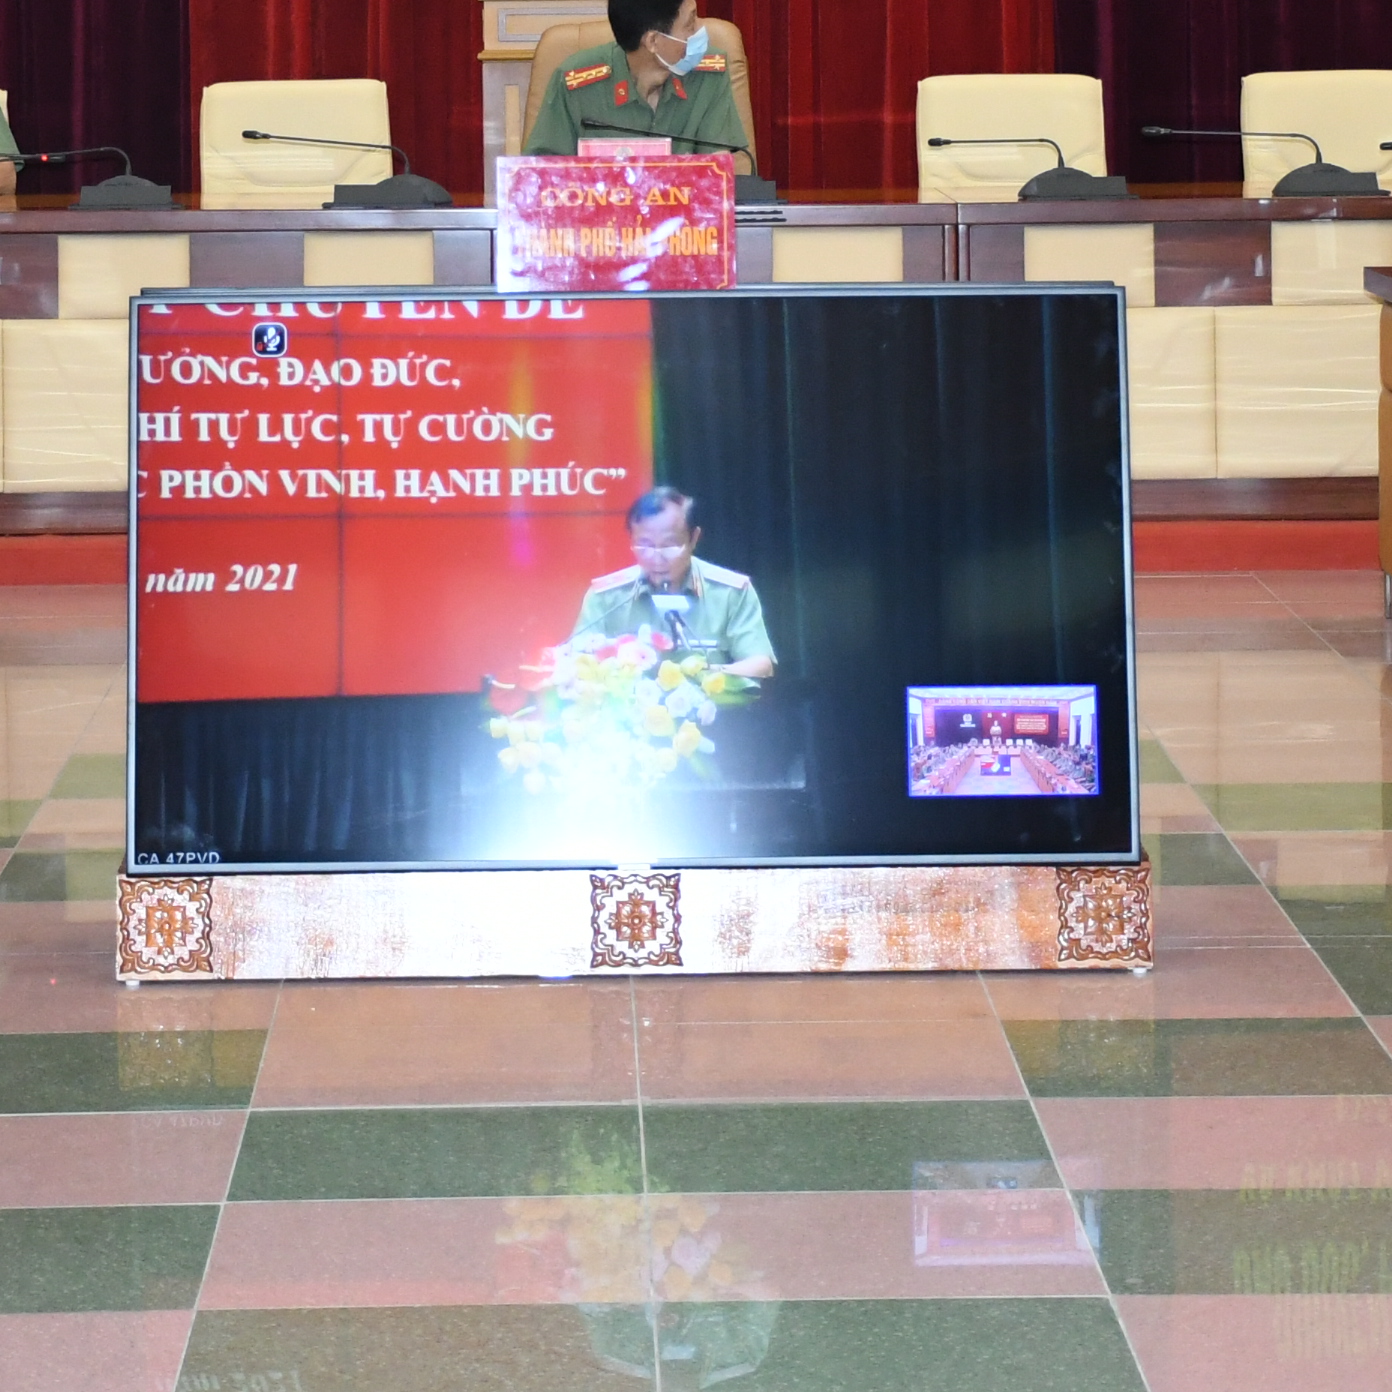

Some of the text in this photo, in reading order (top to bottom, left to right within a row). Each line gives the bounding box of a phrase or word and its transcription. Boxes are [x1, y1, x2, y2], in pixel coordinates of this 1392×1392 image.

[540, 182, 691, 206] CÔNG AN
[278, 358, 362, 393] ĐẠO
[371, 353, 461, 390] ĐỨC,
[191, 409, 249, 449] TỰ
[256, 409, 350, 449] LỰC,
[357, 411, 412, 449] TỰ
[417, 406, 554, 443] CƯỜNG
[278, 469, 386, 500] VINH,
[394, 469, 501, 503] HẠNH
[145, 564, 298, 593] năm 2021
[138, 853, 160, 864] CA
